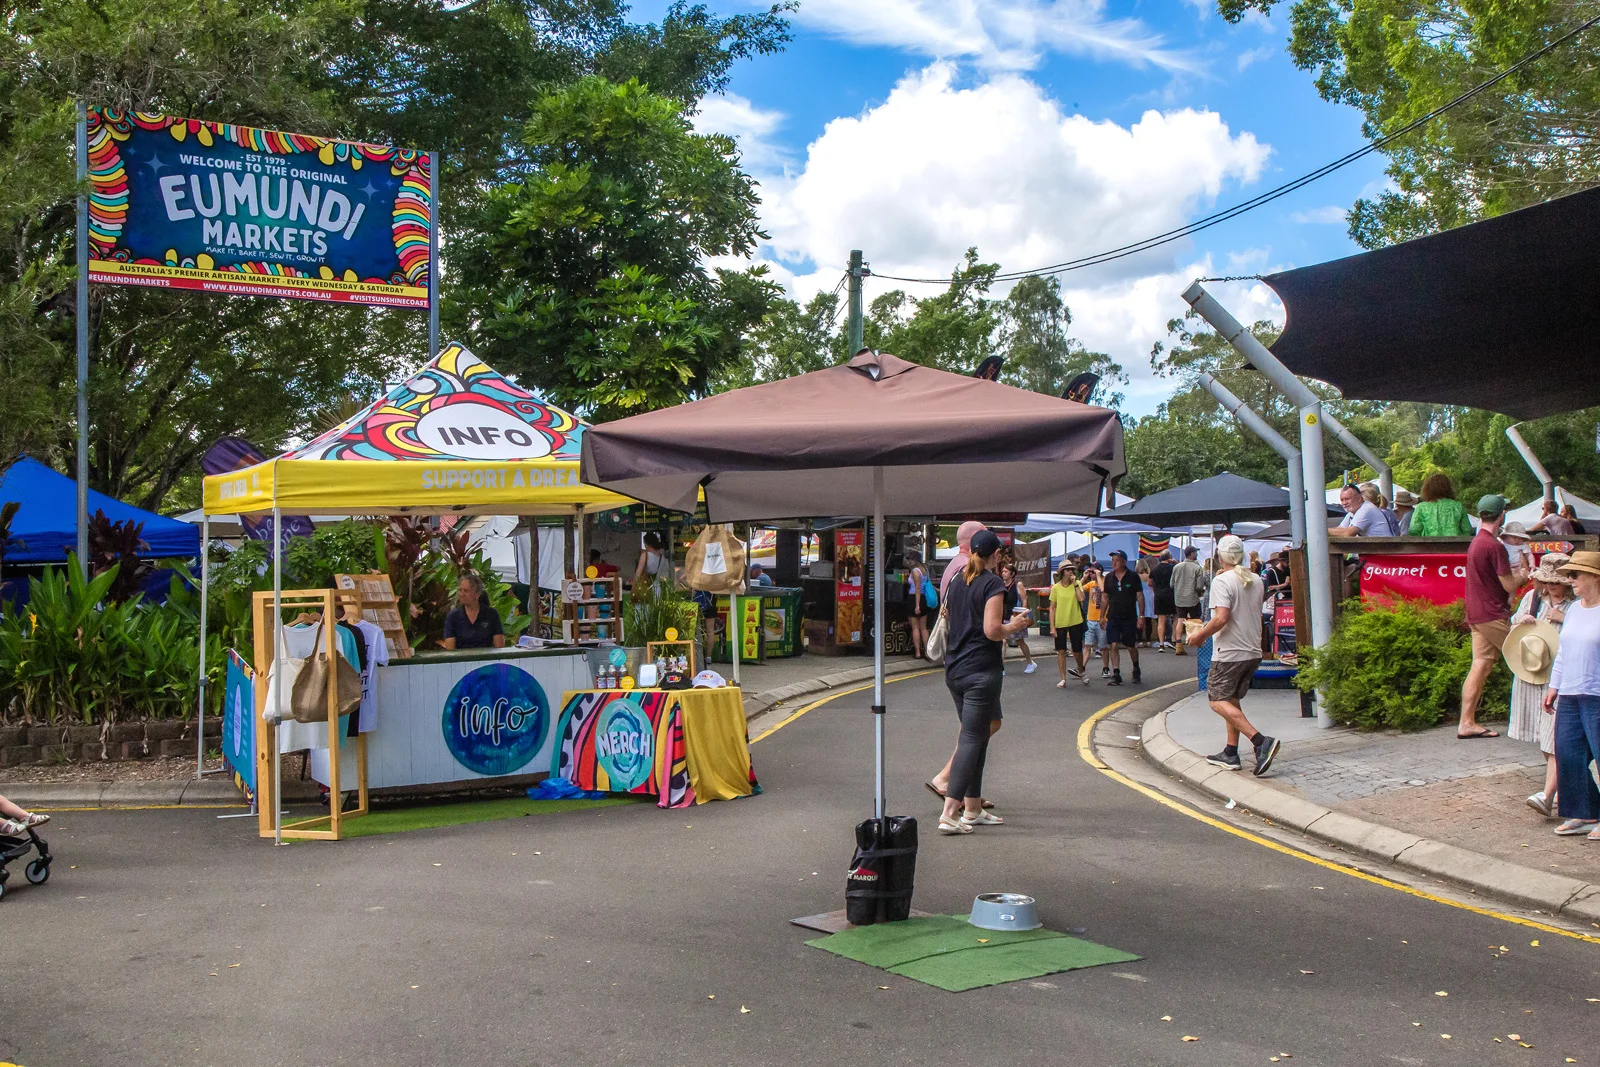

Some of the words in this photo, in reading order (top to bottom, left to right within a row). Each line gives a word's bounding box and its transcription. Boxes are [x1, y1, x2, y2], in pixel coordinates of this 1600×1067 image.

[180, 154, 242, 171] WELCOME
[245, 162, 262, 173] TO
[265, 165, 287, 176] THE
[290, 168, 348, 184] ORIGINAL
[246, 154, 261, 162] EST
[264, 155, 286, 165] 1979
[159, 172, 365, 240] EUMUNDI
[202, 218, 328, 256] MARKETS
[206, 246, 226, 254] MAKE
[228, 248, 236, 256] IT,
[270, 252, 284, 260] SEW
[88, 274, 170, 286] #EUMUNDIMARKETS
[203, 283, 332, 299] WWW.EUMUNDIMARKETS.COM.AU
[350, 294, 428, 306] #VISITSUNSHINECOAST
[119, 264, 172, 275] AUSTRALIA'S
[175, 270, 209, 278] PREMIER
[212, 272, 246, 281] ARTISAN
[248, 275, 280, 284] MARKET
[287, 279, 310, 287] EVERY
[311, 281, 358, 290] WEDNESDAY
[367, 285, 404, 294] SATURDAY
[437, 427, 532, 446] INFO
[422, 469, 508, 488] SUPPORT
[512, 470, 526, 488] A
[530, 468, 582, 488] DREA
[1364, 564, 1427, 580] gourmet
[745, 602, 756, 656] SATAY
[459, 696, 538, 746] info
[596, 732, 652, 758] MERCH
